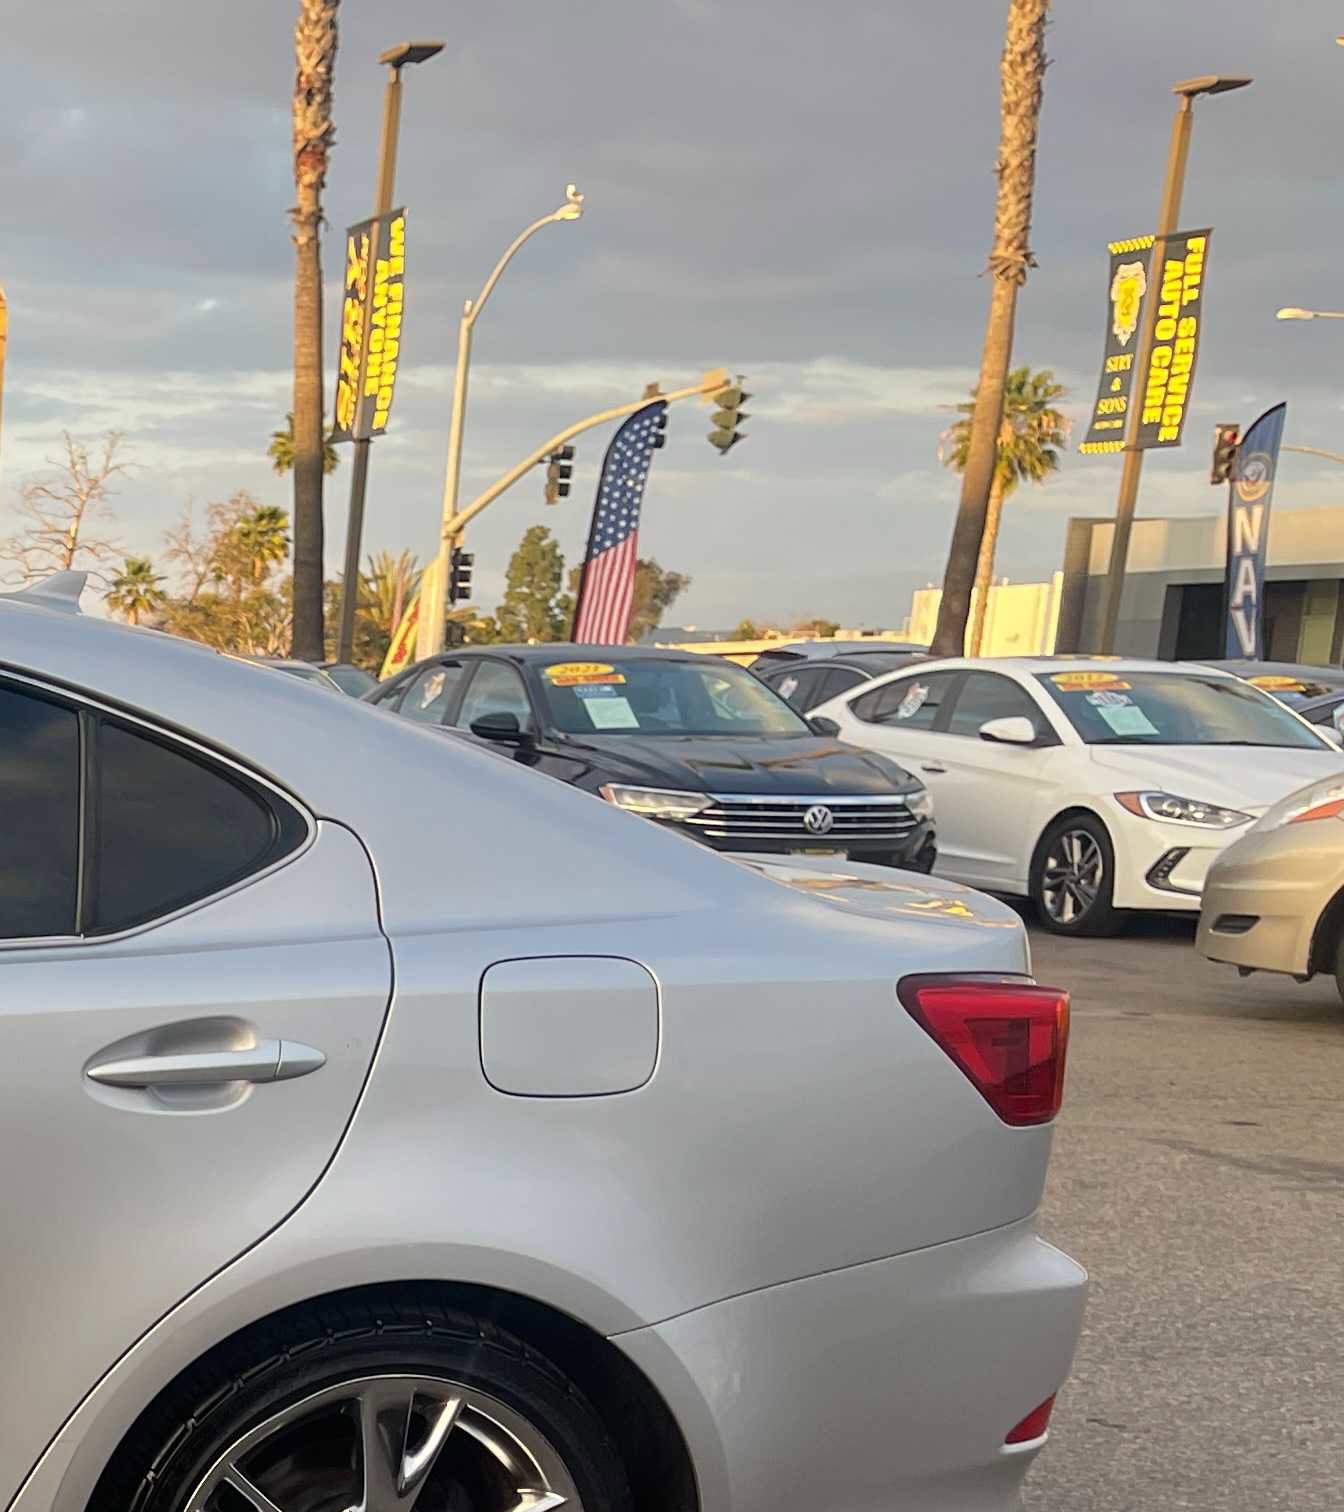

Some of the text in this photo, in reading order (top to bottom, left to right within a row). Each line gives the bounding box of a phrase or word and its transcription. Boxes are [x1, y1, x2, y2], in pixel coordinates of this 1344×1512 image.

[364, 259, 390, 396] ANYONE
[372, 216, 405, 430] WE FINANCE
[1142, 259, 1185, 425] AUTO CARE
[1157, 236, 1206, 442] FULL SERVICE
